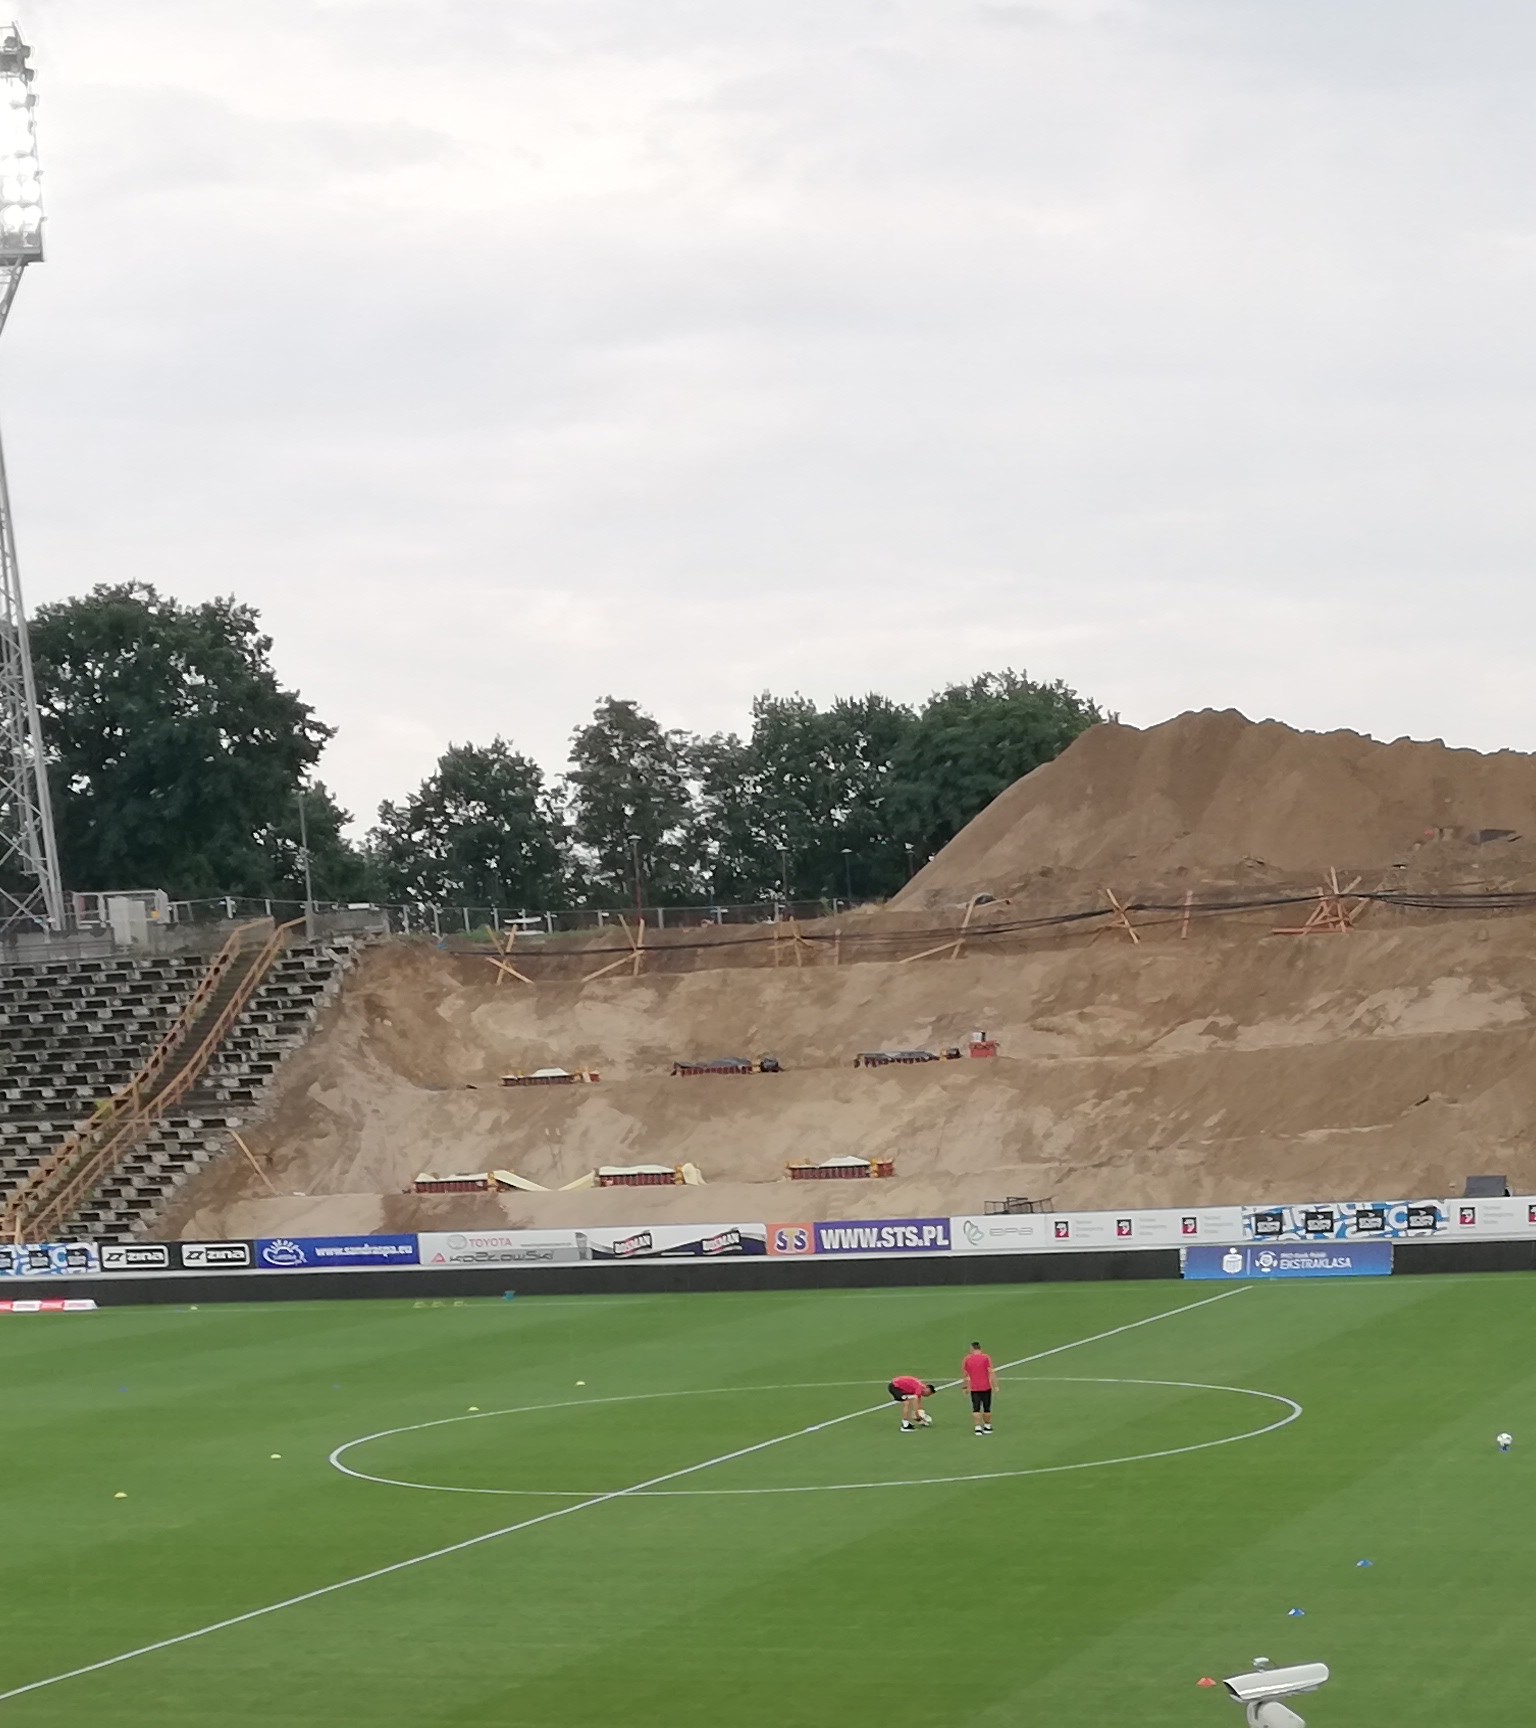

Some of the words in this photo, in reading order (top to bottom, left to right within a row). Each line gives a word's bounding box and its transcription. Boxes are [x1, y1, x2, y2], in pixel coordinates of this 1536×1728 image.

[468, 1237, 512, 1248] TOYOTA
[775, 1229, 808, 1252] STS
[819, 1225, 950, 1250] WWW.STS.PL
[1280, 1257, 1352, 1271] EKSTRAKLASA
